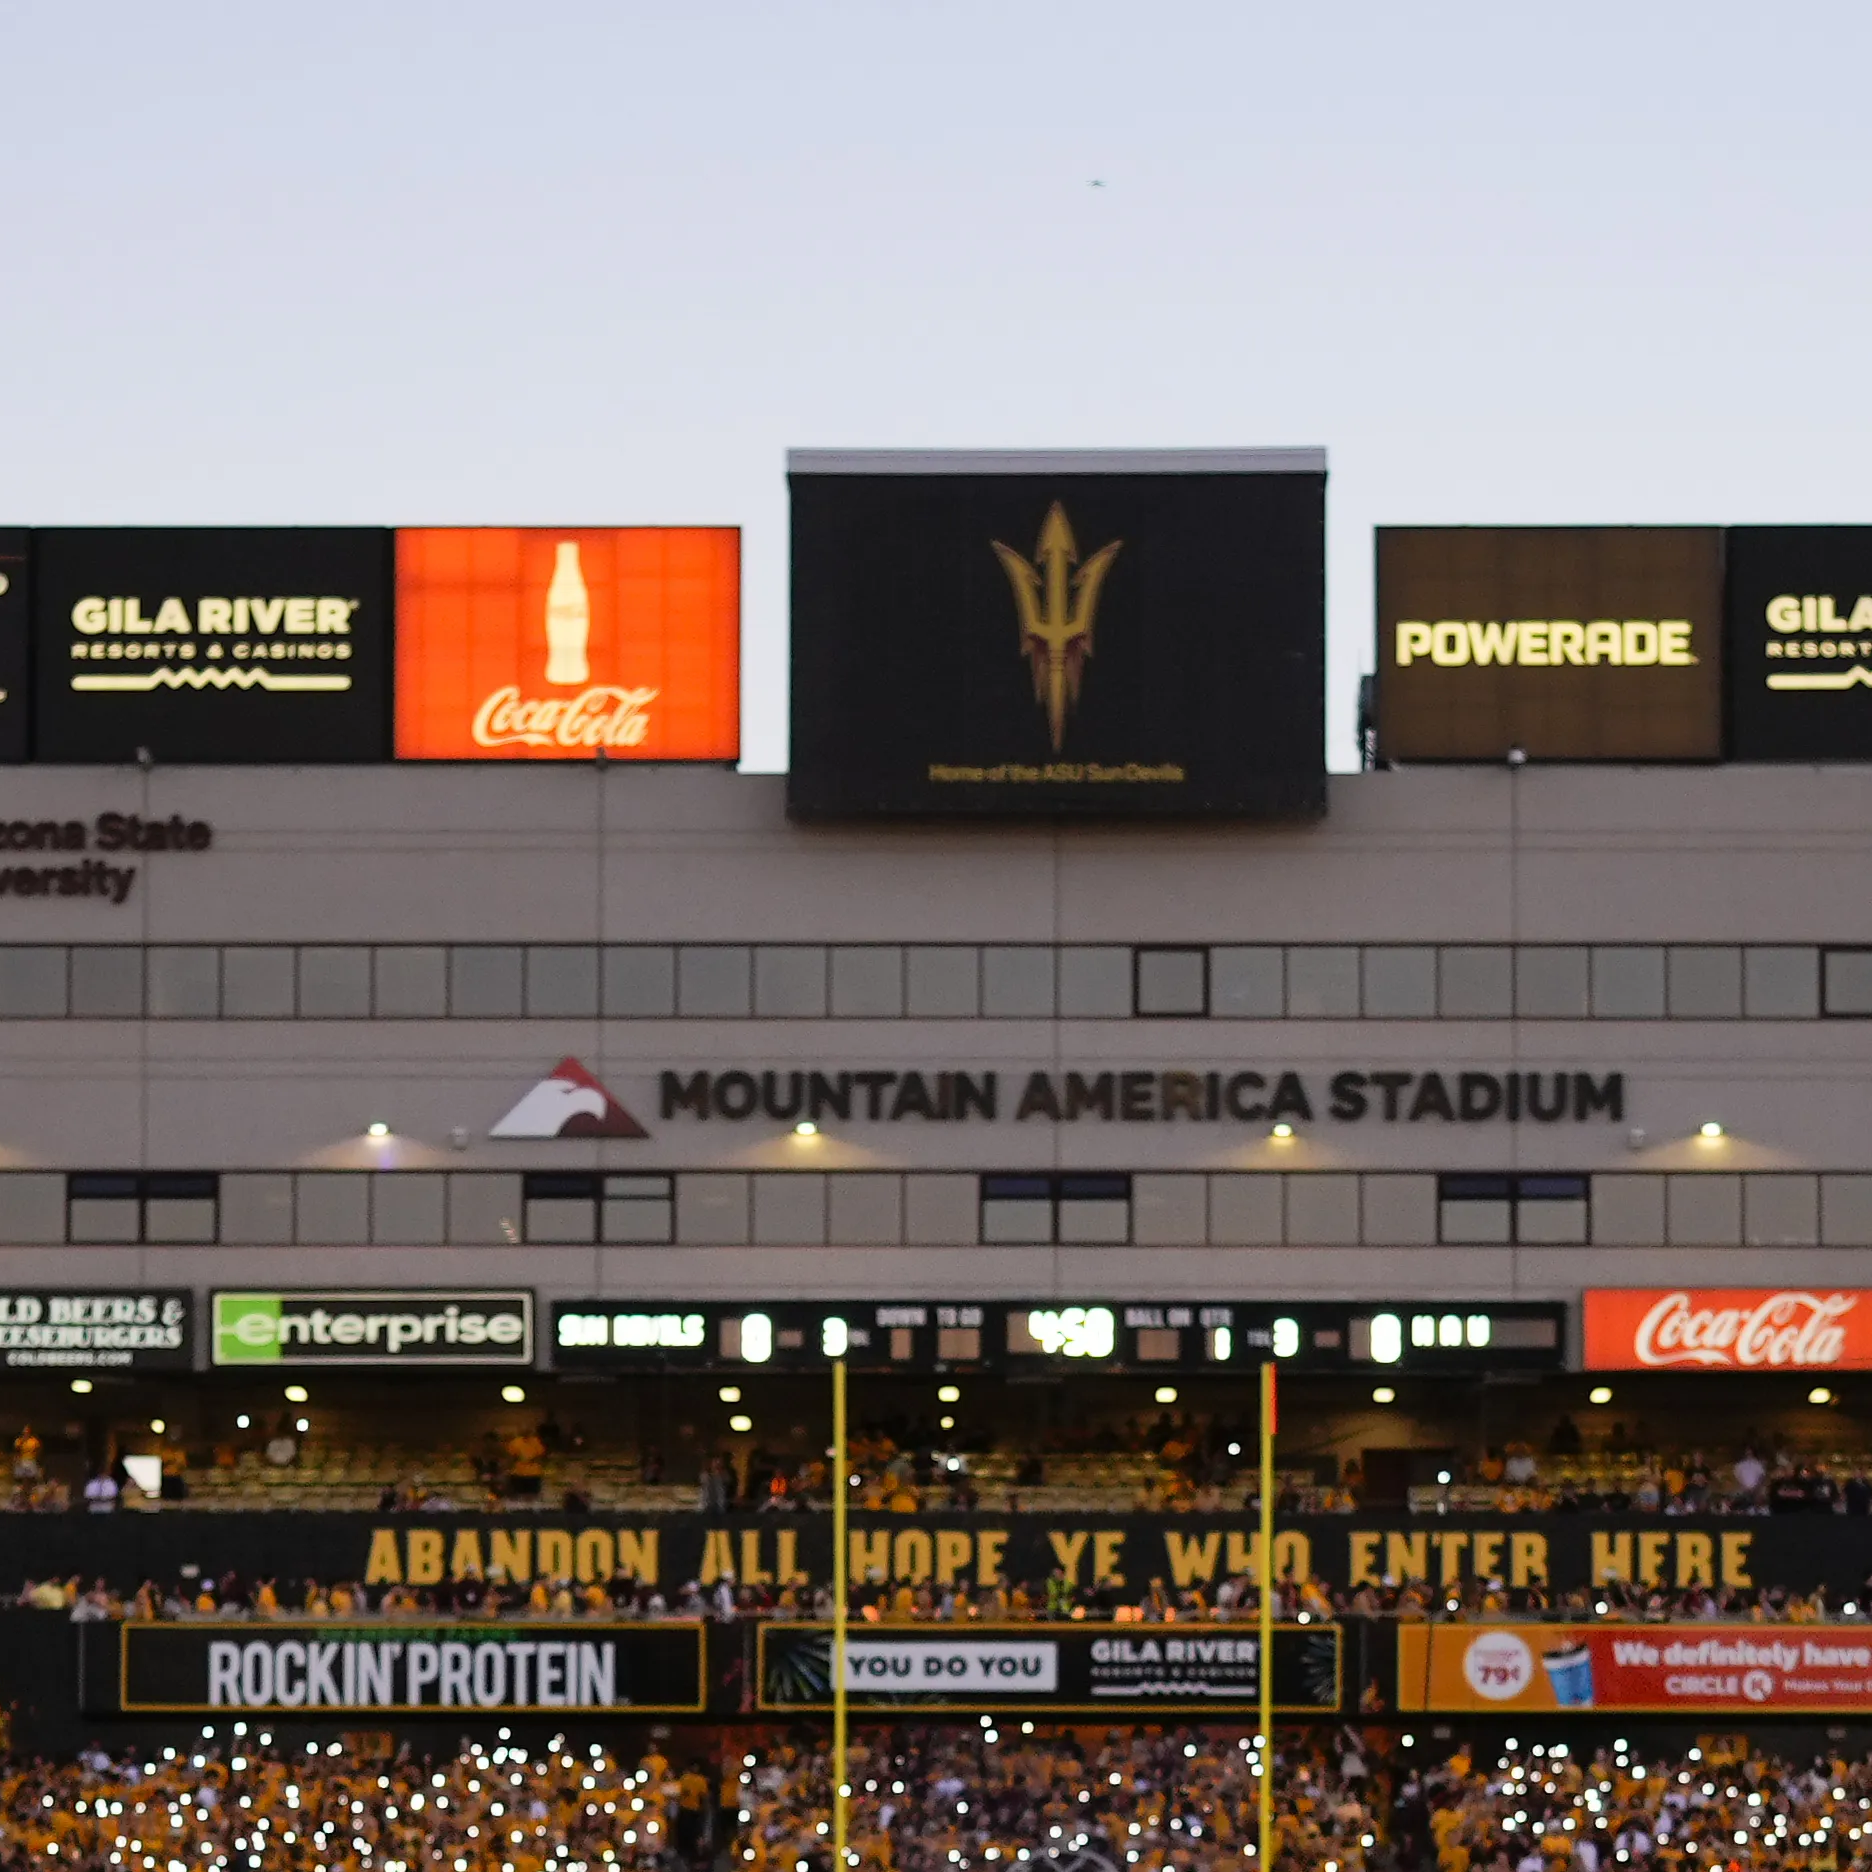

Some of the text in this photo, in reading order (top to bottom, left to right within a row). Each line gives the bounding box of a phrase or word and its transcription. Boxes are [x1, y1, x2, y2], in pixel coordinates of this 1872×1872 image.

[71, 597, 352, 634] GILA RIVER
[70, 641, 352, 660] RESORTS & CASINOS
[1396, 621, 1687, 667] POWERADE
[929, 764, 983, 782] Home
[1008, 764, 1039, 782] the
[96, 813, 213, 854] State
[658, 1069, 1624, 1125] MOUNTAIN AMERICA STADIUM
[48, 1297, 157, 1325] BEERS
[161, 1299, 186, 1325] &
[233, 1304, 523, 1353] enterprise
[365, 1528, 1754, 1588] ABANDON ALL HOPE YE WHO ENTER HERE
[848, 1655, 1044, 1677] YOU DO YOU
[1091, 1639, 1255, 1664] GILA RIVER
[1613, 1640, 1662, 1665] We
[1663, 1640, 1801, 1672] definitely
[1804, 1642, 1871, 1668] have
[208, 1641, 616, 1707] ROCKIN' PROTEIN
[1665, 1676, 1739, 1698] CIRCLE
[1783, 1678, 1828, 1694] Makes
[1832, 1678, 1863, 1694] Your
